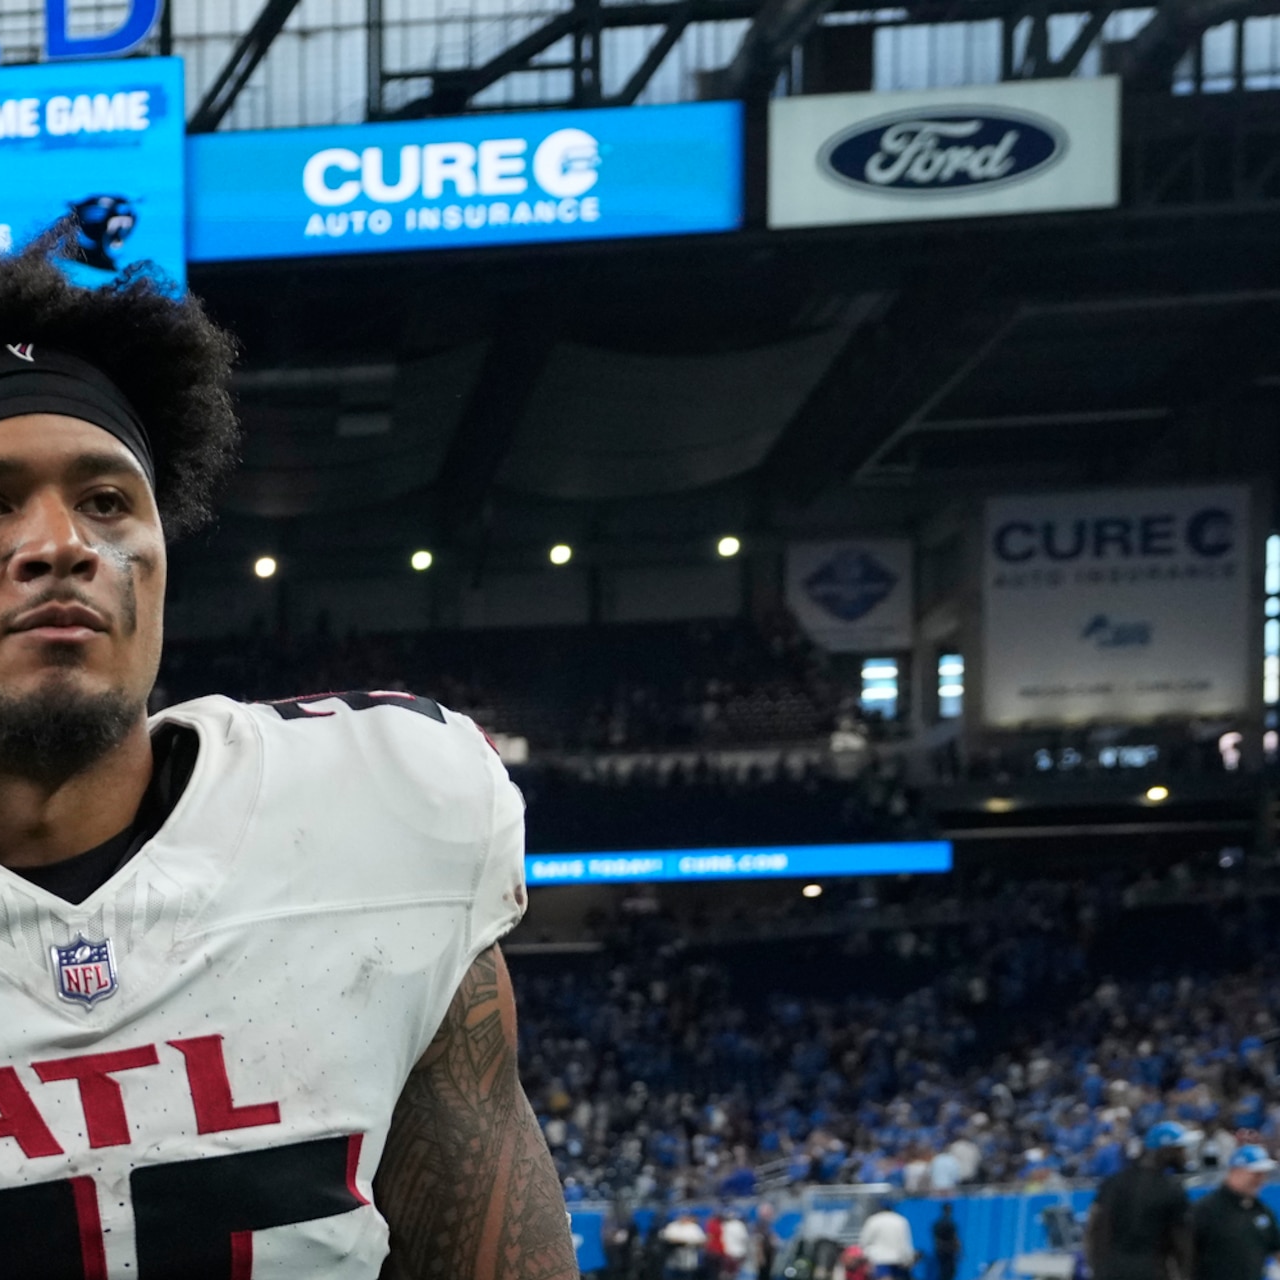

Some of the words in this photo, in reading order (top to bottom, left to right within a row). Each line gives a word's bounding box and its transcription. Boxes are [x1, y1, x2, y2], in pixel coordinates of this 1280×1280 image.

[45, 90, 150, 136] GAME
[864, 119, 1020, 185] Ford
[304, 208, 392, 238] AUTO
[404, 196, 602, 232] INSURANCE
[65, 964, 109, 995] NFL
